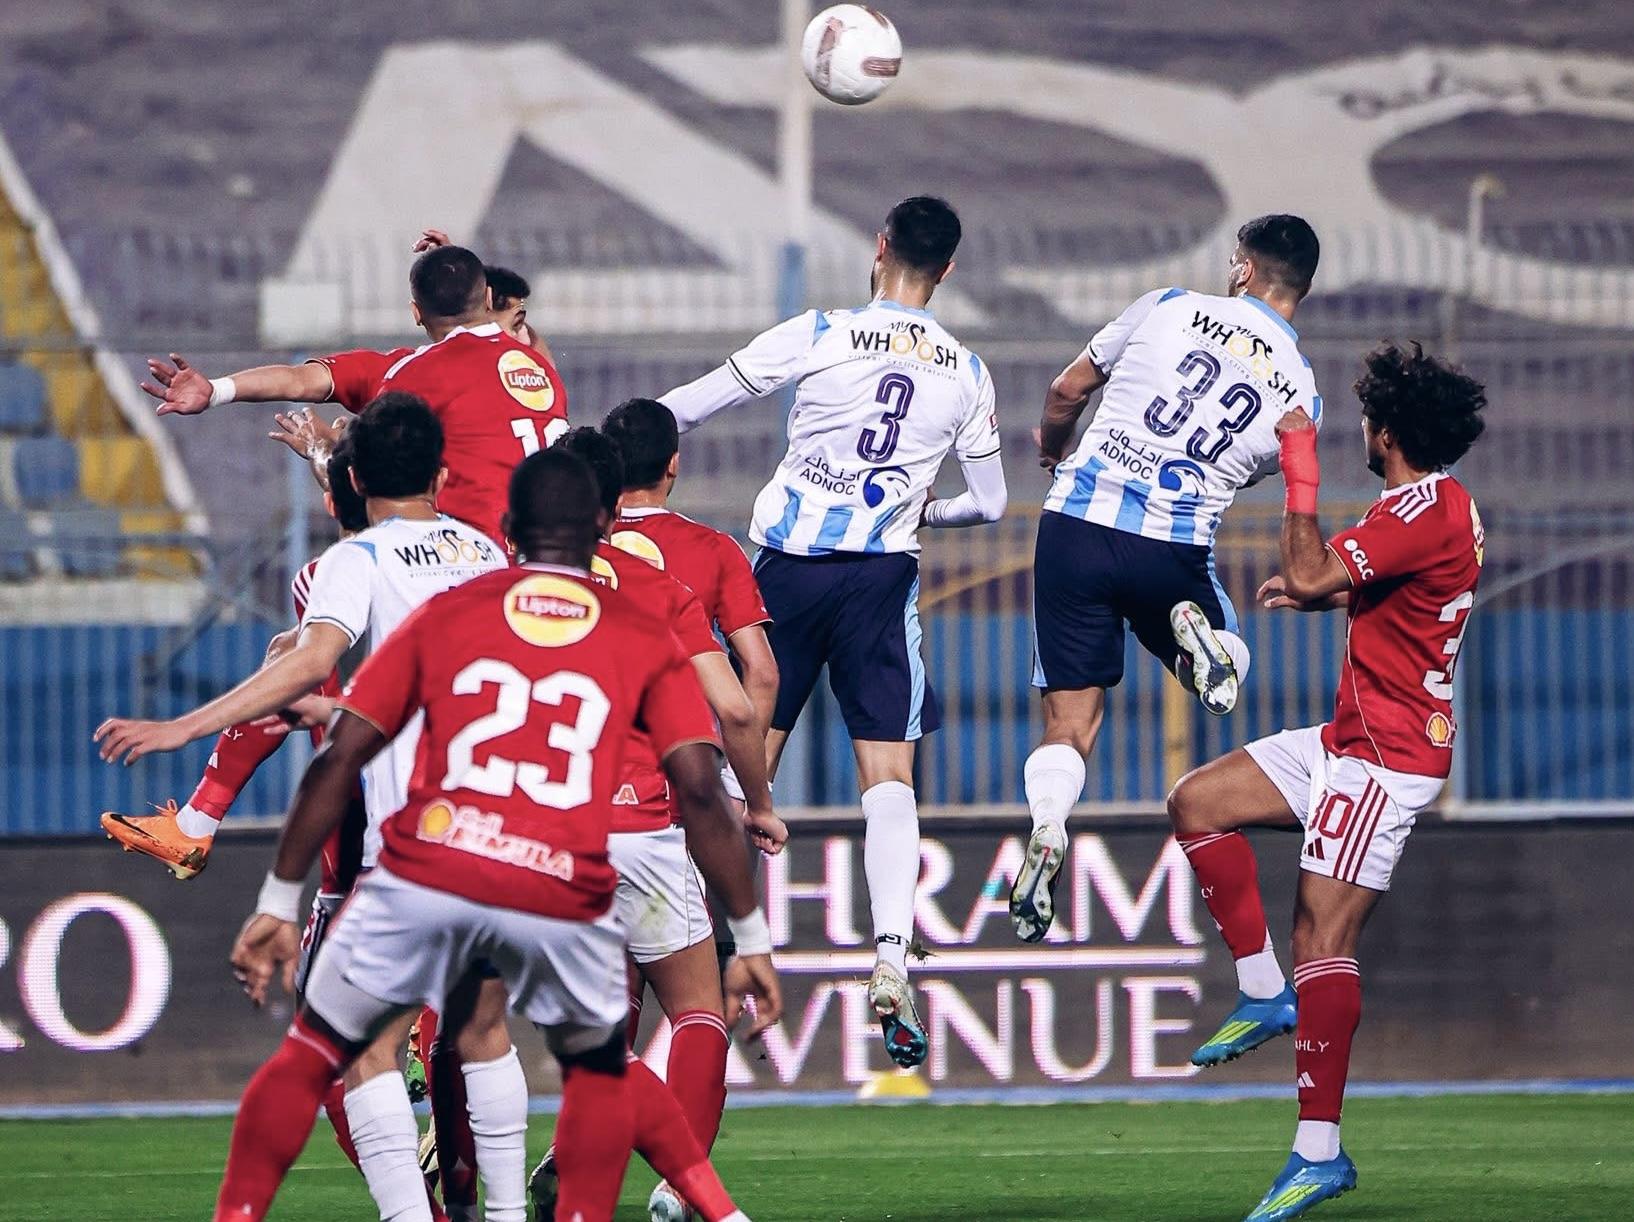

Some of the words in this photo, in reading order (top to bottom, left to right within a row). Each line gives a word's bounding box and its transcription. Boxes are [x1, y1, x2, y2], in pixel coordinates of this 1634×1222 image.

[850, 327, 958, 370] WHOOSH
[1191, 311, 1298, 404] WHOOSH
[508, 372, 546, 389] Lipton
[857, 373, 914, 464] 3
[1144, 350, 1262, 465] 33
[1098, 441, 1153, 480] ADNOC
[799, 468, 856, 495] ADNOC
[1352, 549, 1374, 581] GLC
[517, 596, 588, 619] Lipton
[441, 657, 612, 810] 23
